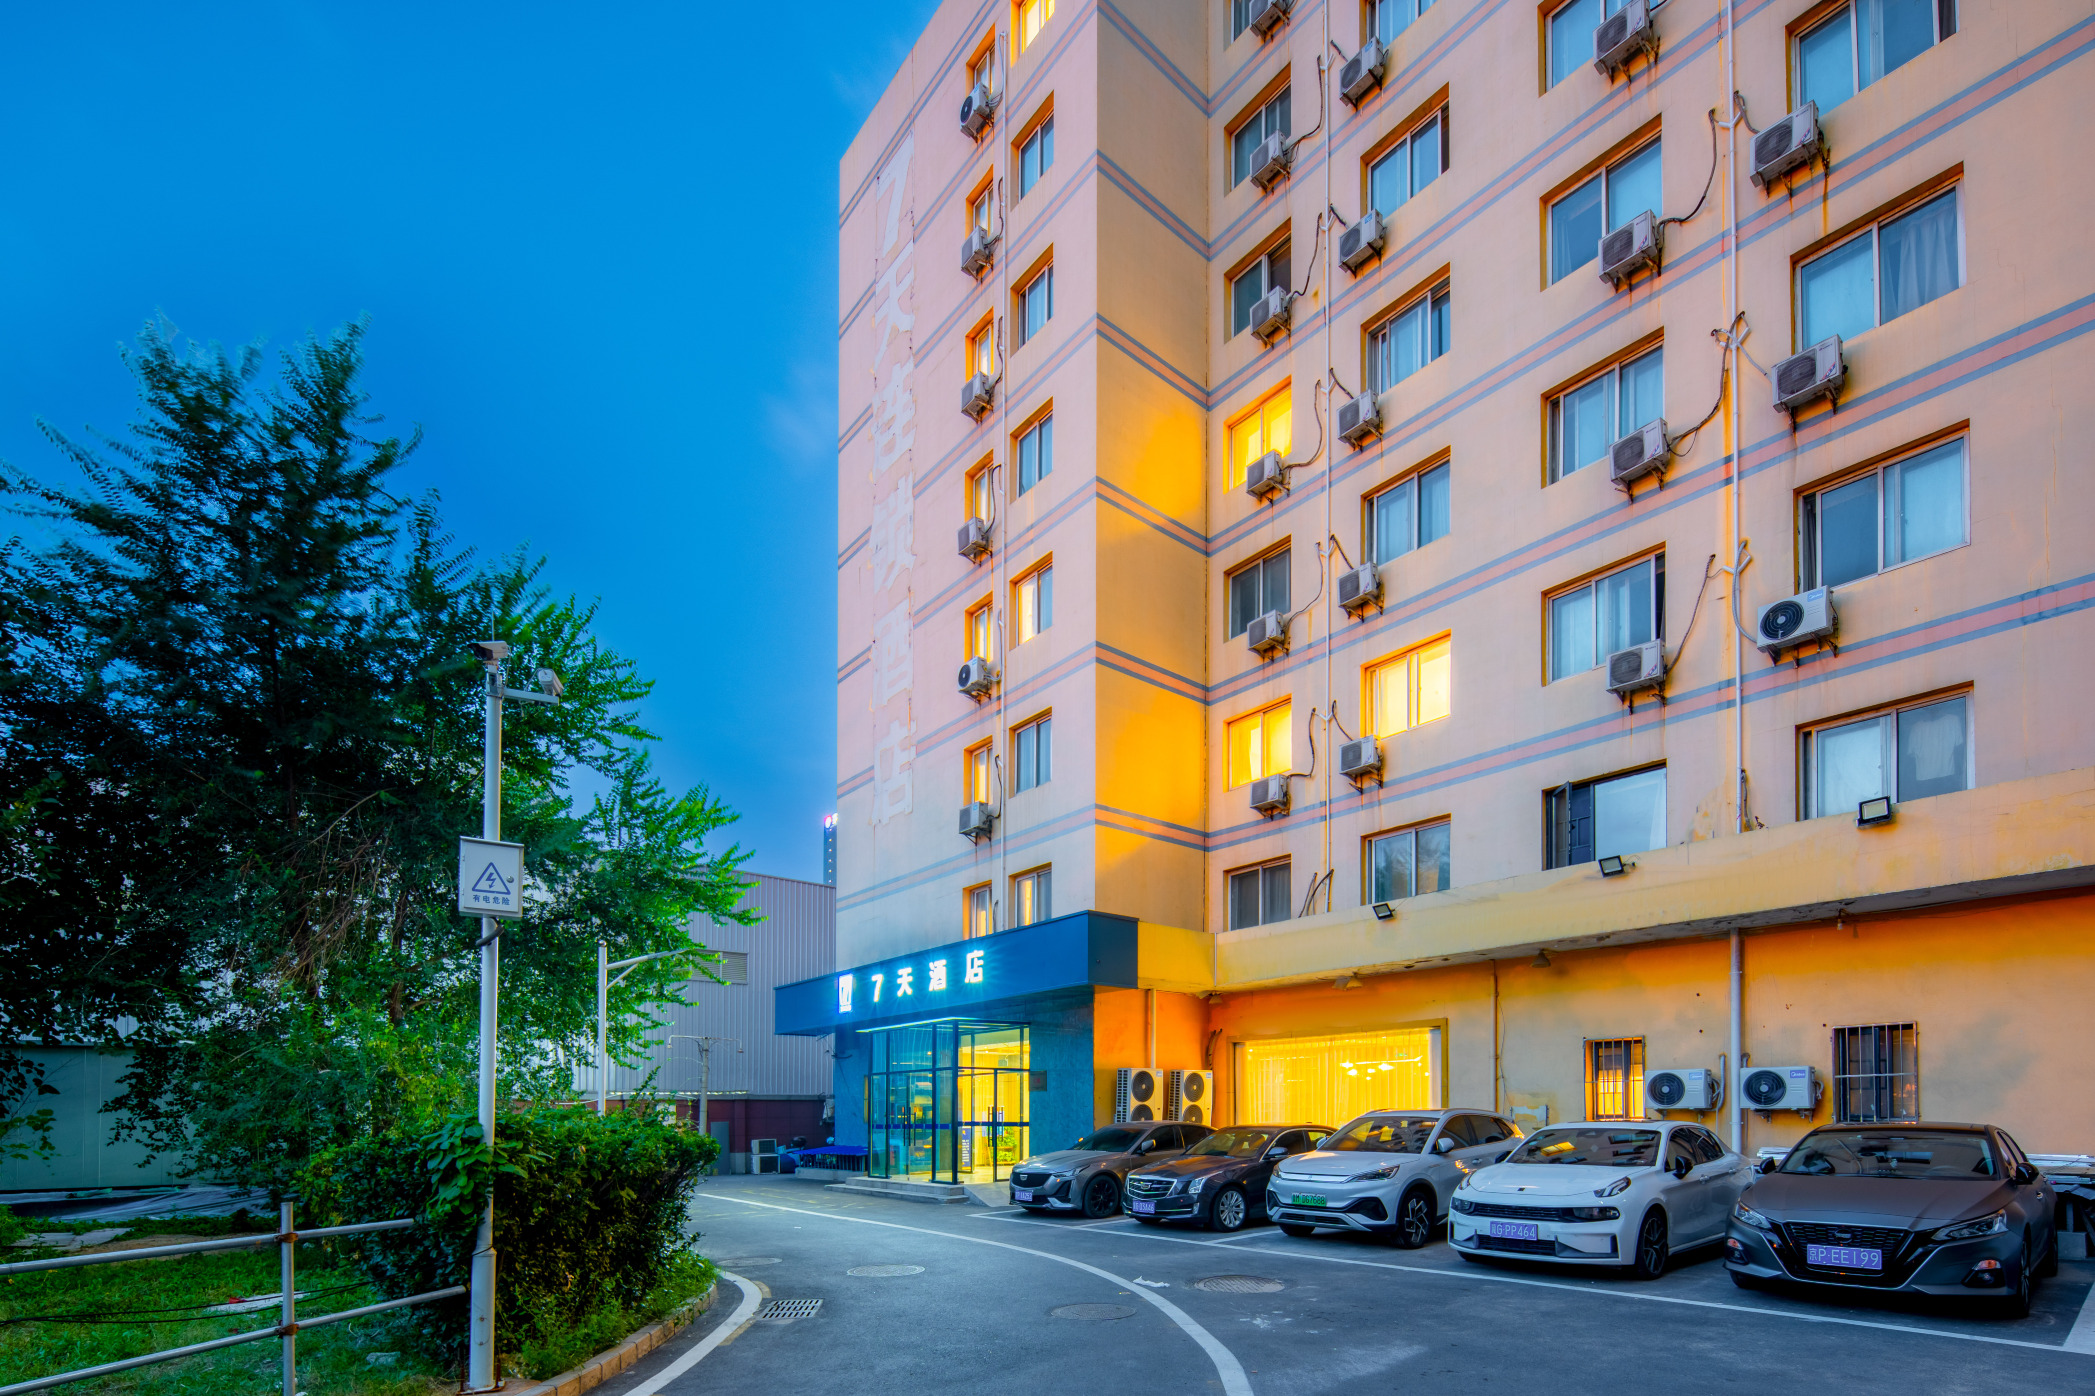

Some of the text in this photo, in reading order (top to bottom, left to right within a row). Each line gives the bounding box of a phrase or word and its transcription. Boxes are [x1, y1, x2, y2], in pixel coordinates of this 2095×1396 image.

[472, 894, 511, 906] 有电危险
[871, 949, 984, 1002] 7天酒店
